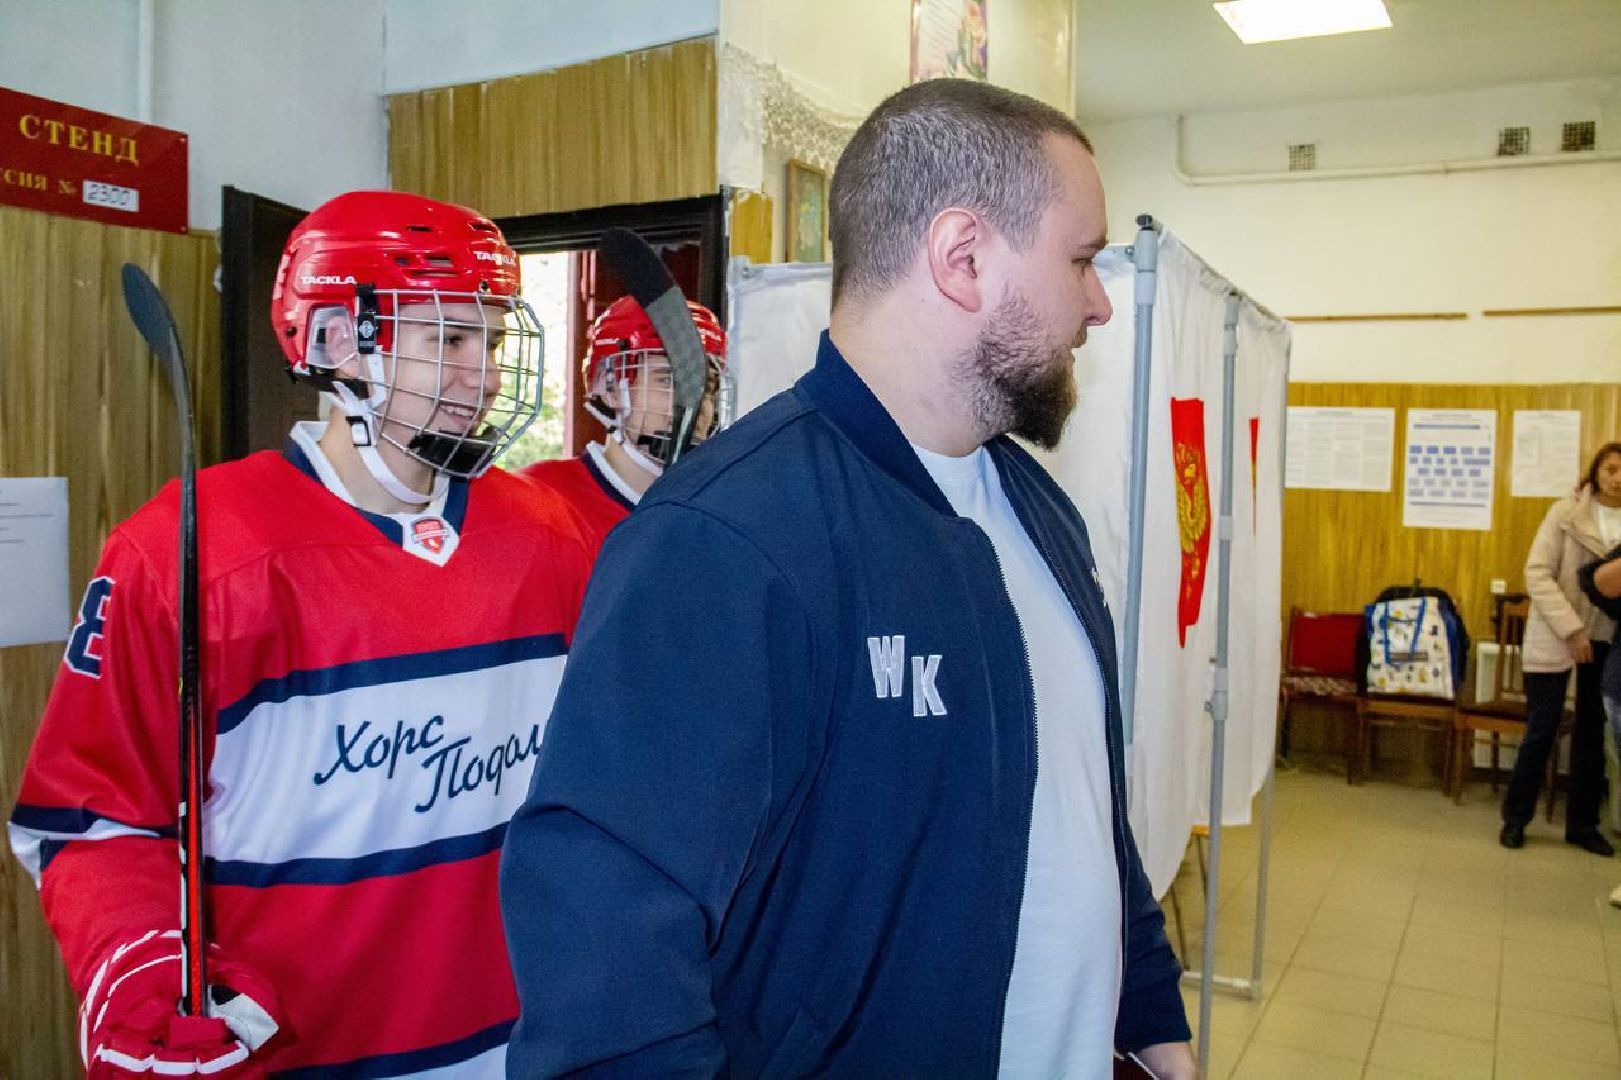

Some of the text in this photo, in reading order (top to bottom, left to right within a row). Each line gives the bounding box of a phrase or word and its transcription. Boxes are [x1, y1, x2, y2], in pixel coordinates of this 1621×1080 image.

[19, 114, 139, 167] СТЕНД
[0, 168, 47, 191] СИЯ
[300, 276, 358, 285] TACKLA
[314, 715, 444, 786] Хорс
[415, 724, 541, 813] Подол
